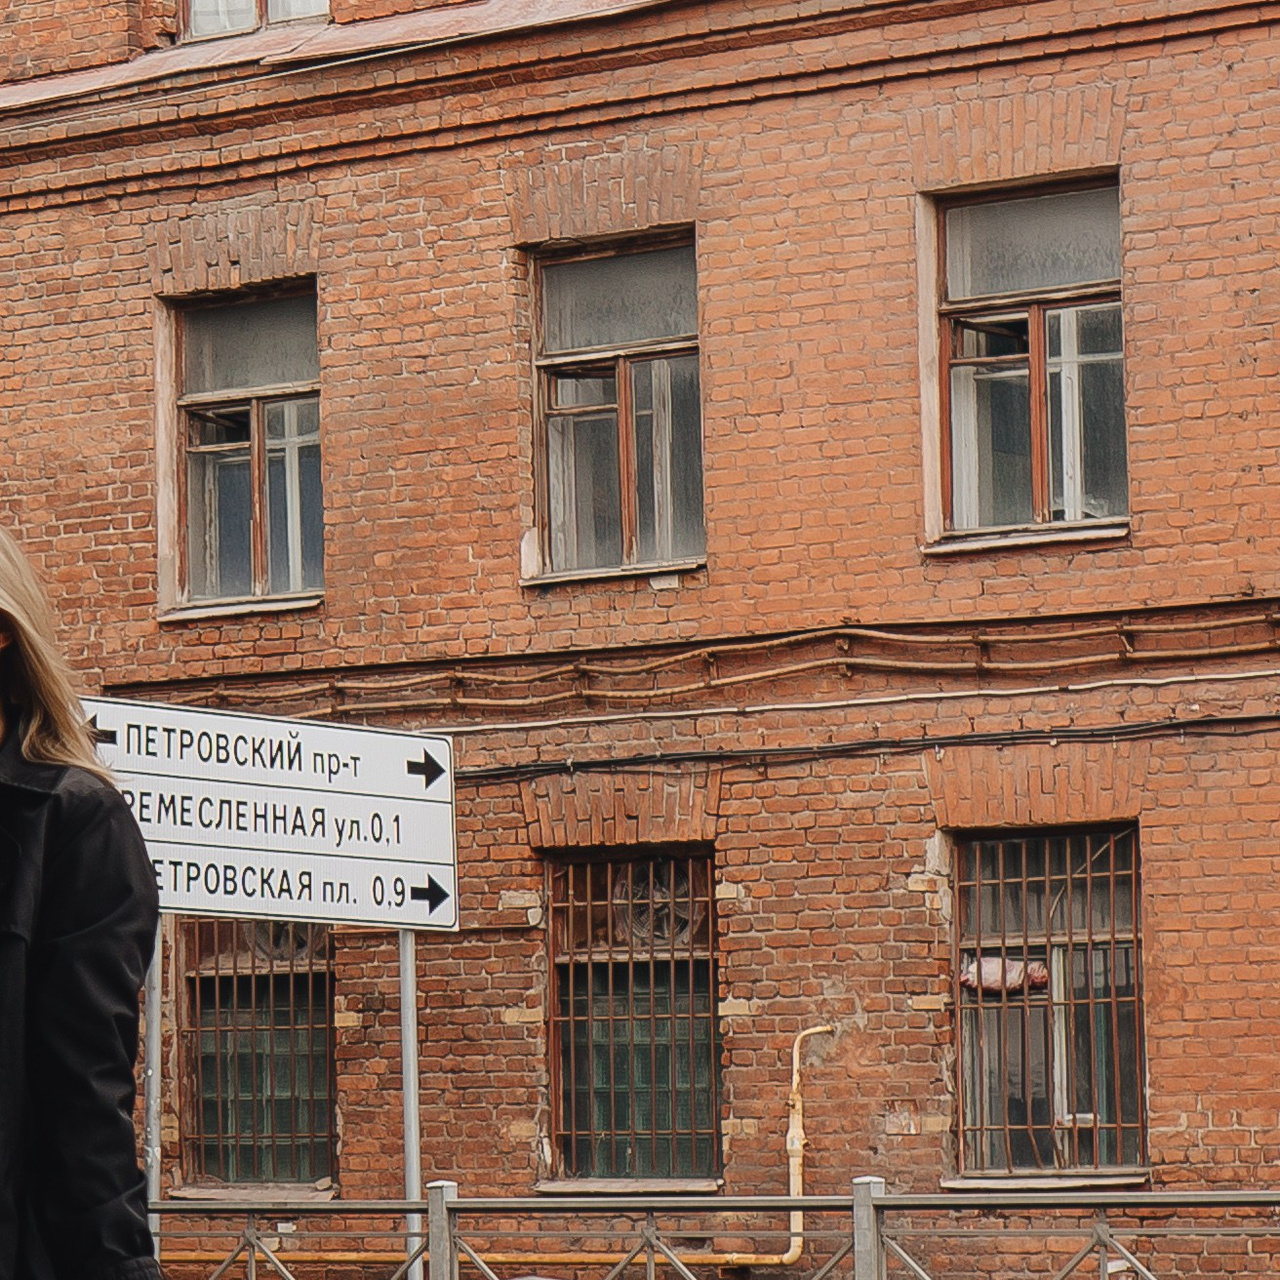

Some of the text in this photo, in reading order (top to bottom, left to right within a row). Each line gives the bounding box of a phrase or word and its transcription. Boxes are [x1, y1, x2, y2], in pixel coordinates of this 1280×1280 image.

[126, 723, 362, 784] ПЕТРОВСКИЙ пр-т
[122, 790, 326, 838] РЕМЕСЛЕННАЯ
[152, 859, 406, 909] ЕТРОВСКАЯ пл. 0,9
